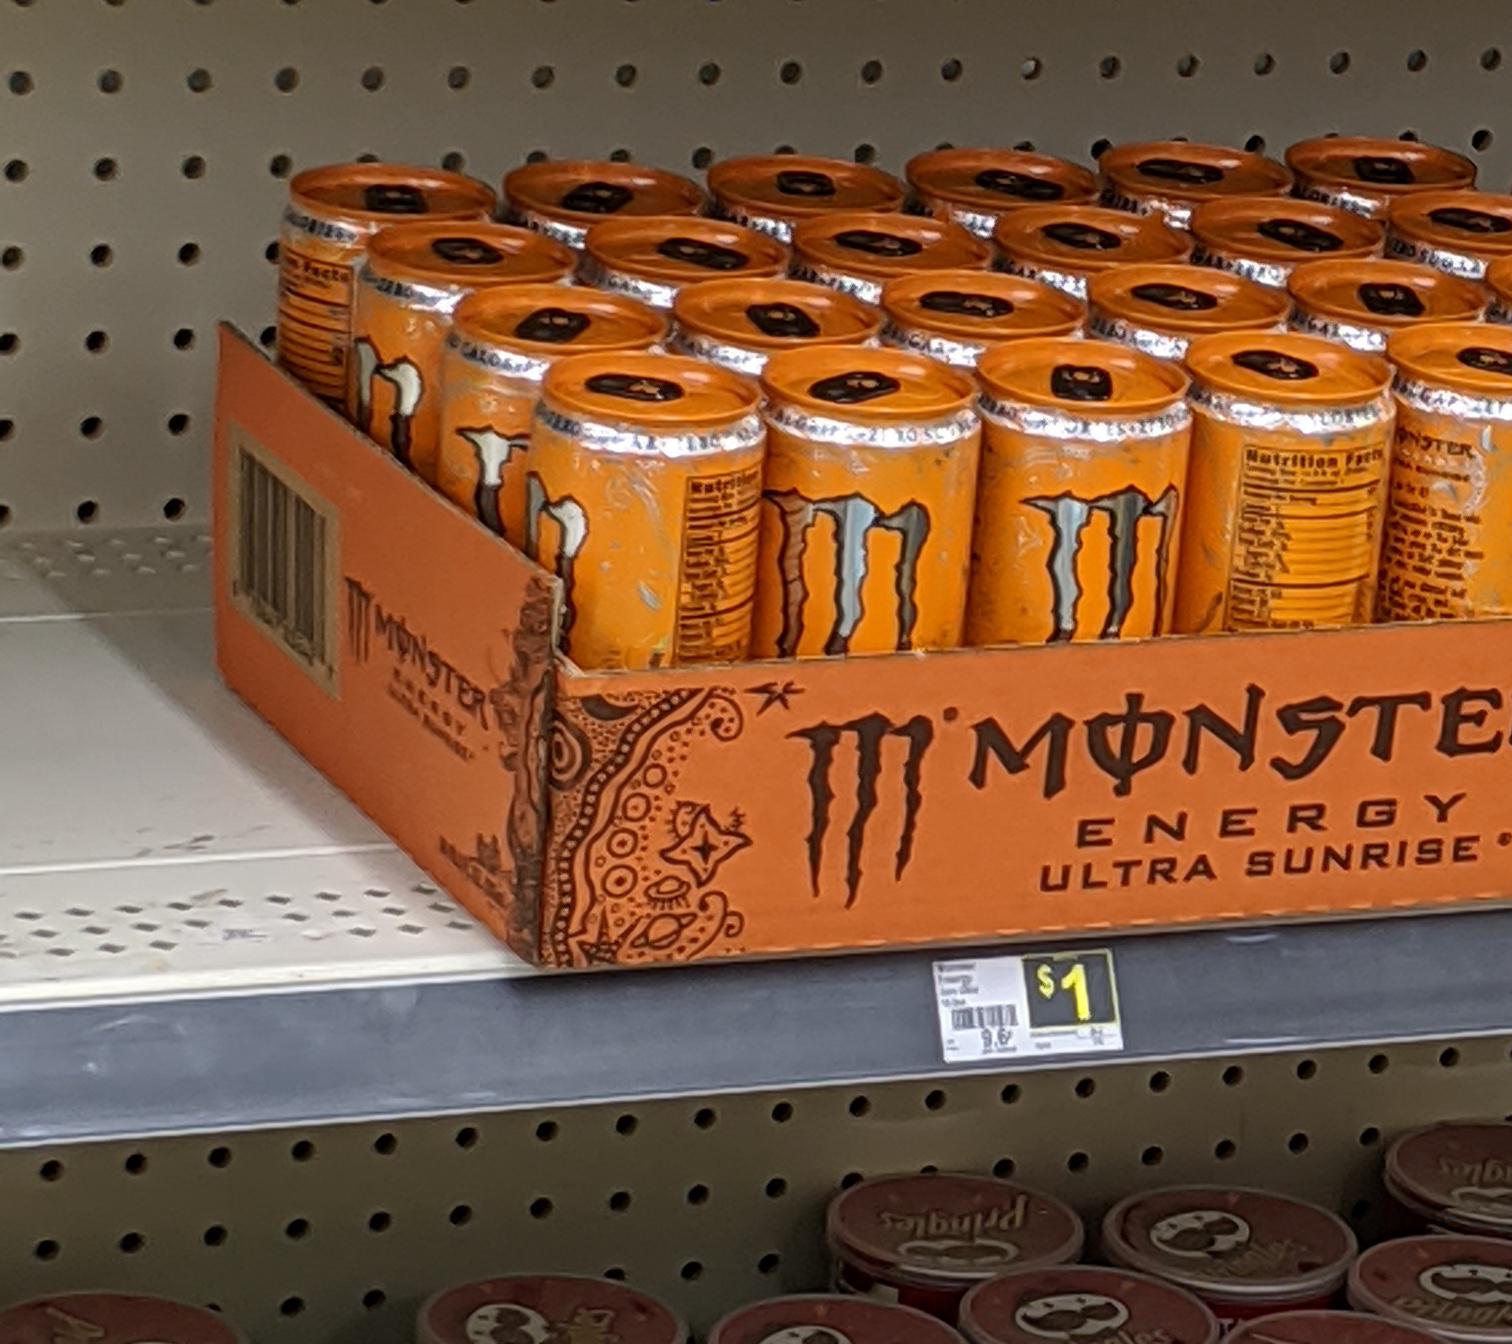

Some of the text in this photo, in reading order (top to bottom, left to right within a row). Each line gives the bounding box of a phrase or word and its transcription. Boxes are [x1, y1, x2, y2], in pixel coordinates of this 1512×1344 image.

[1245, 448, 1339, 470] Nutrition
[373, 603, 489, 730] MONSTER
[1074, 792, 1468, 849] ENERGY
[1040, 834, 1481, 893] ULTRA SUNRISE
[1037, 963, 1091, 1021] $1
